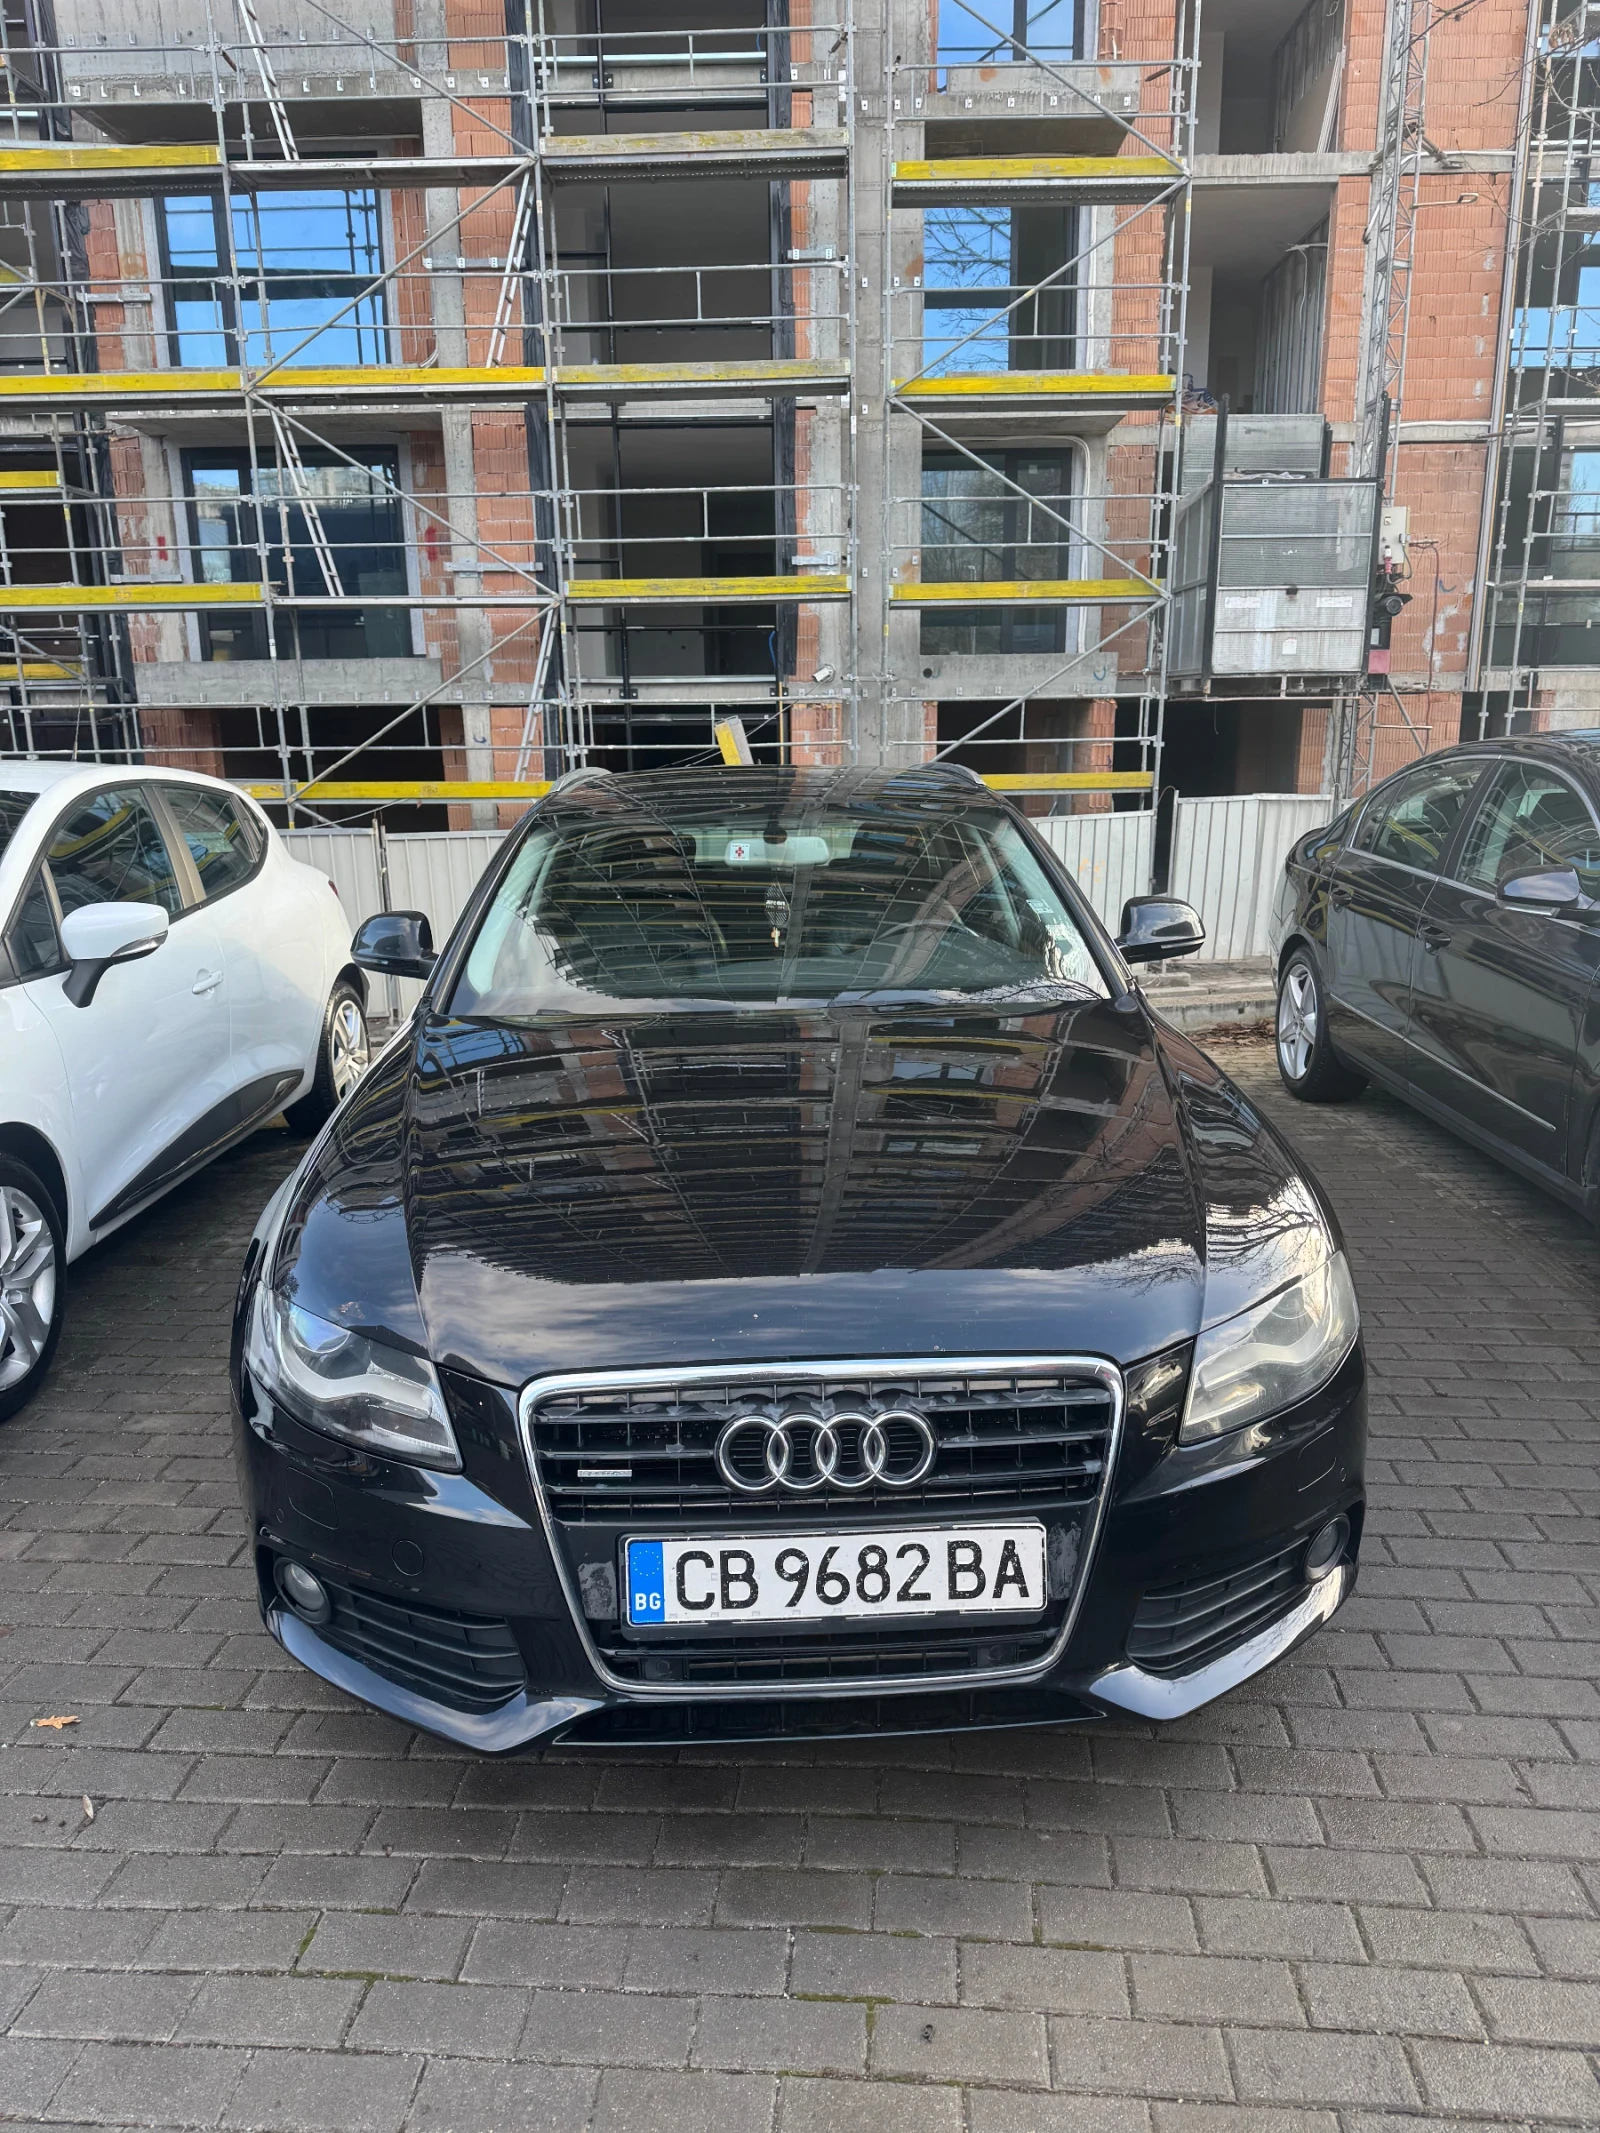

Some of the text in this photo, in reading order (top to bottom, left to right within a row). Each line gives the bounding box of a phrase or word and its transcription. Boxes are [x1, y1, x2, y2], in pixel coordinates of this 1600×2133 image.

[676, 1538, 1030, 1610] CB 9682 BA
[634, 1592, 661, 1611] BG
